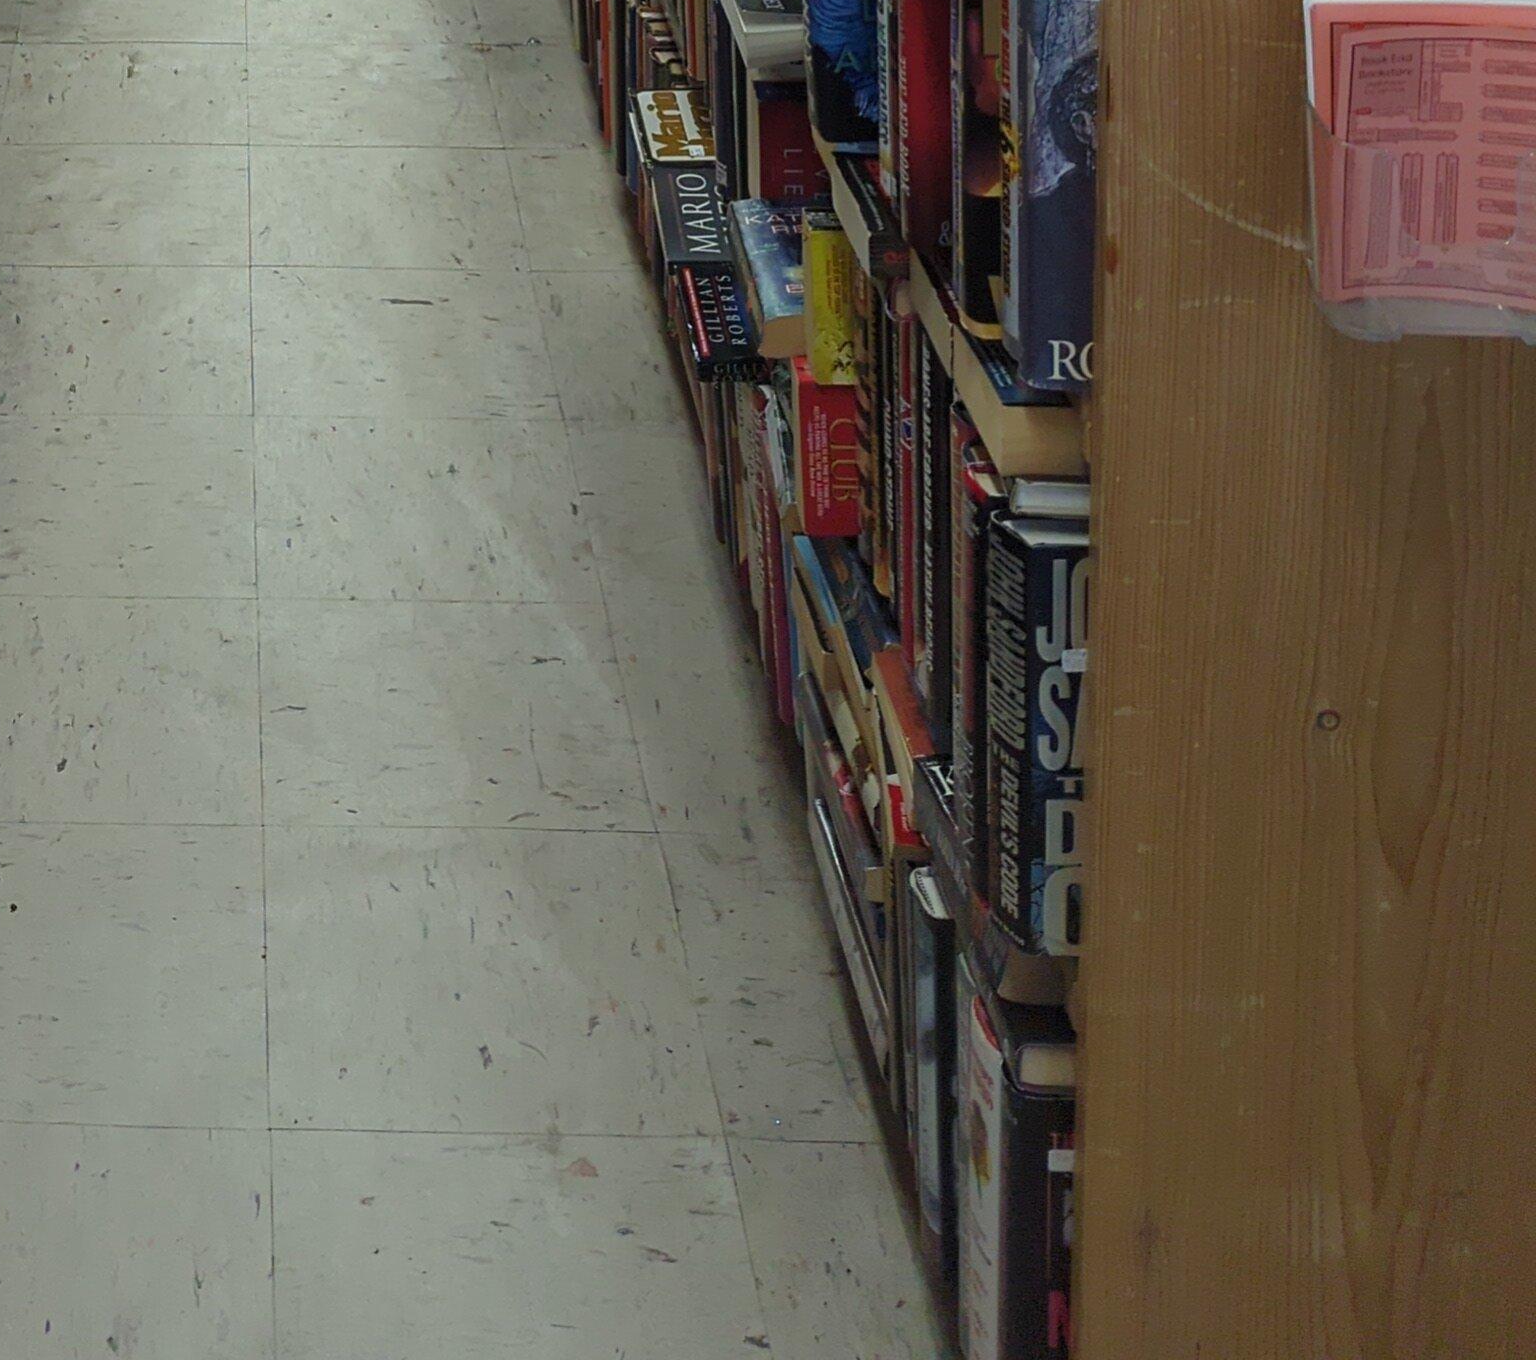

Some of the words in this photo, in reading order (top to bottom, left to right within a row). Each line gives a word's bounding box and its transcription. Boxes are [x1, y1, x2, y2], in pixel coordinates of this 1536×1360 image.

[676, 174, 721, 254] MARIO
[698, 278, 724, 342] GILLIAN
[717, 274, 747, 344] ROBERTS
[988, 606, 1026, 750] SANDFORD
[1001, 773, 1020, 855] DEVIL'S
[1001, 857, 1020, 919] CODE
